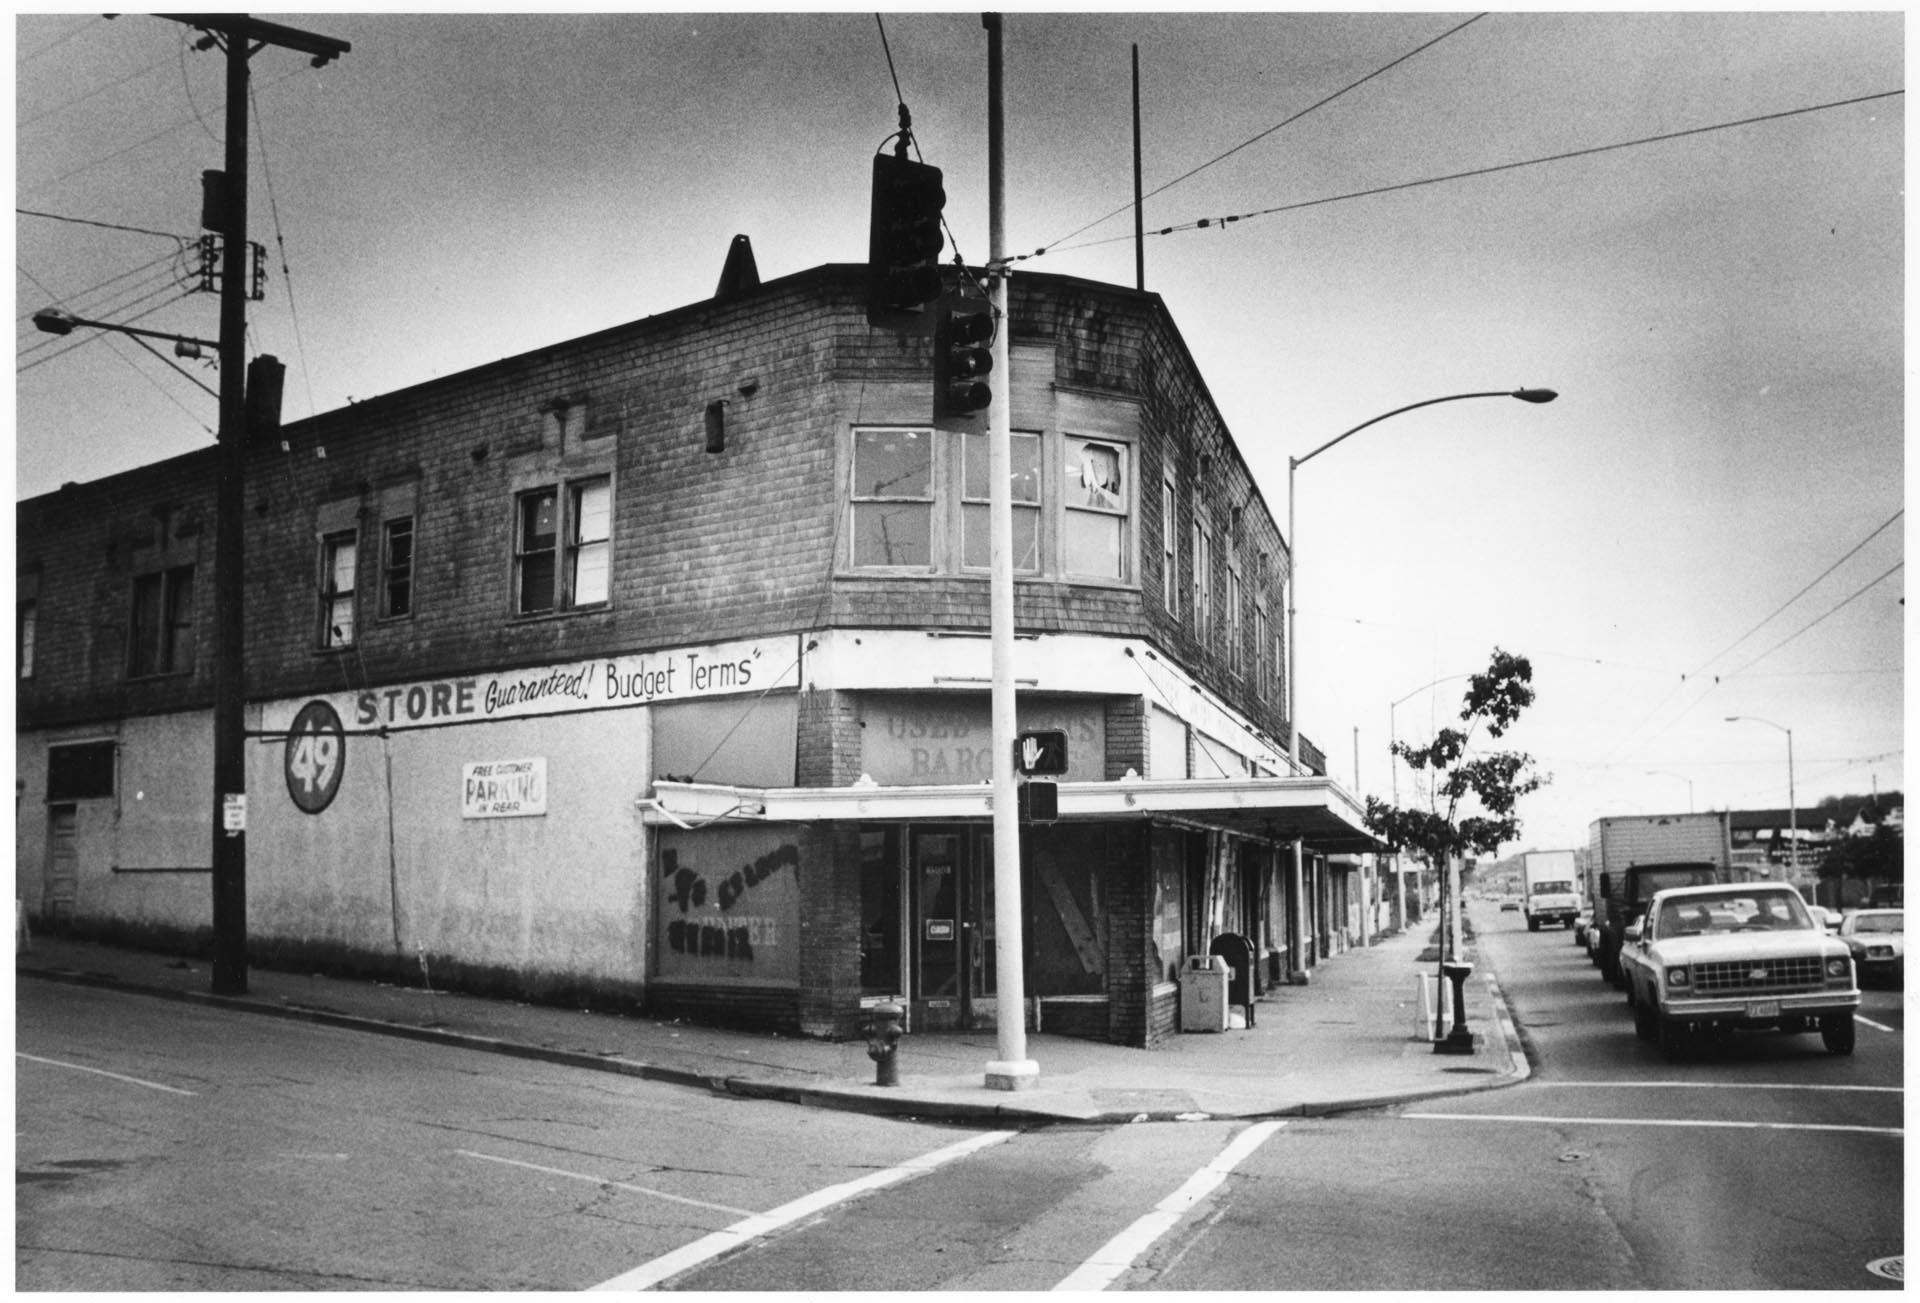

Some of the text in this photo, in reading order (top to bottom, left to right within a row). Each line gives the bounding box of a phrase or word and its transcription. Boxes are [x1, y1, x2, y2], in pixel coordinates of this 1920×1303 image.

[357, 680, 476, 725] STORE
[485, 664, 595, 714] Guaranteed!
[606, 657, 676, 701] Budget
[291, 719, 339, 793] 49
[465, 775, 542, 805] PARKING
